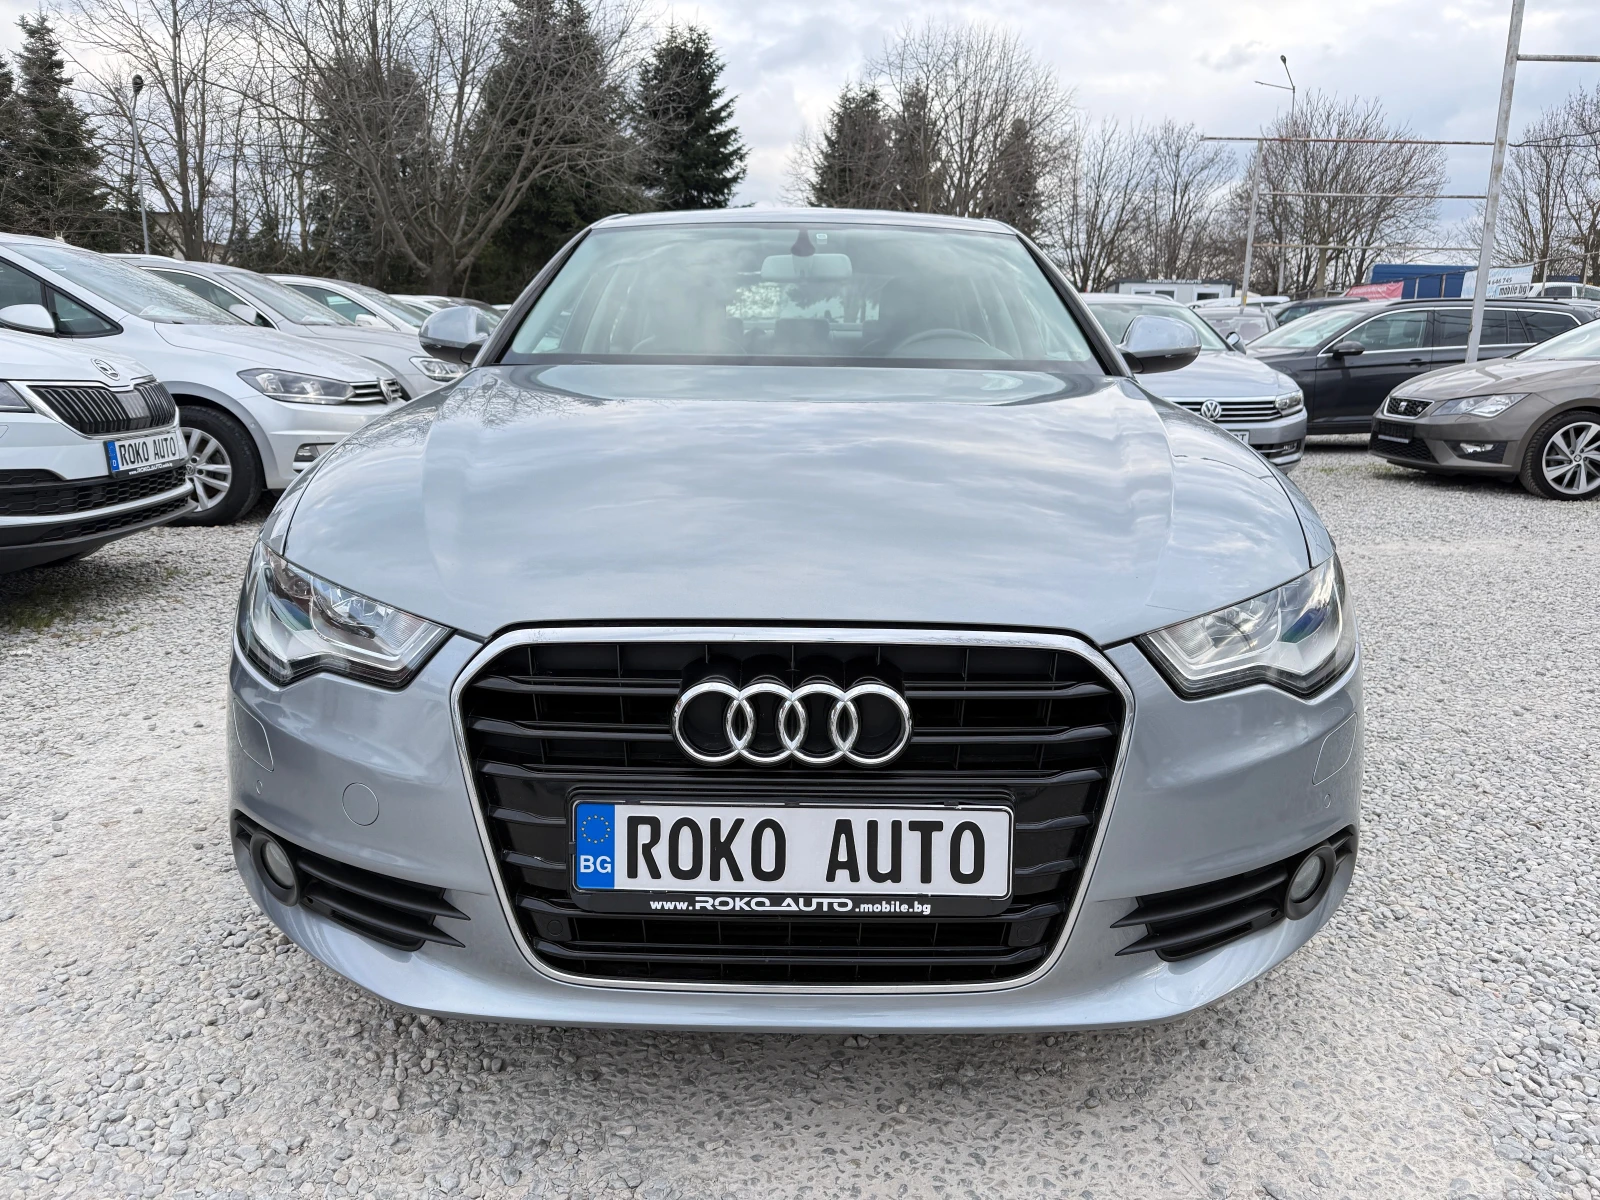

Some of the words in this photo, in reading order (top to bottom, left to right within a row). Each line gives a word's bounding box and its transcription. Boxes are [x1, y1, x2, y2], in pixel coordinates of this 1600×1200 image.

[118, 441, 149, 466] ROKO
[152, 436, 176, 461] AUTO
[579, 854, 612, 873] BG
[626, 815, 787, 882] ROKO
[825, 818, 986, 885] AUTO
